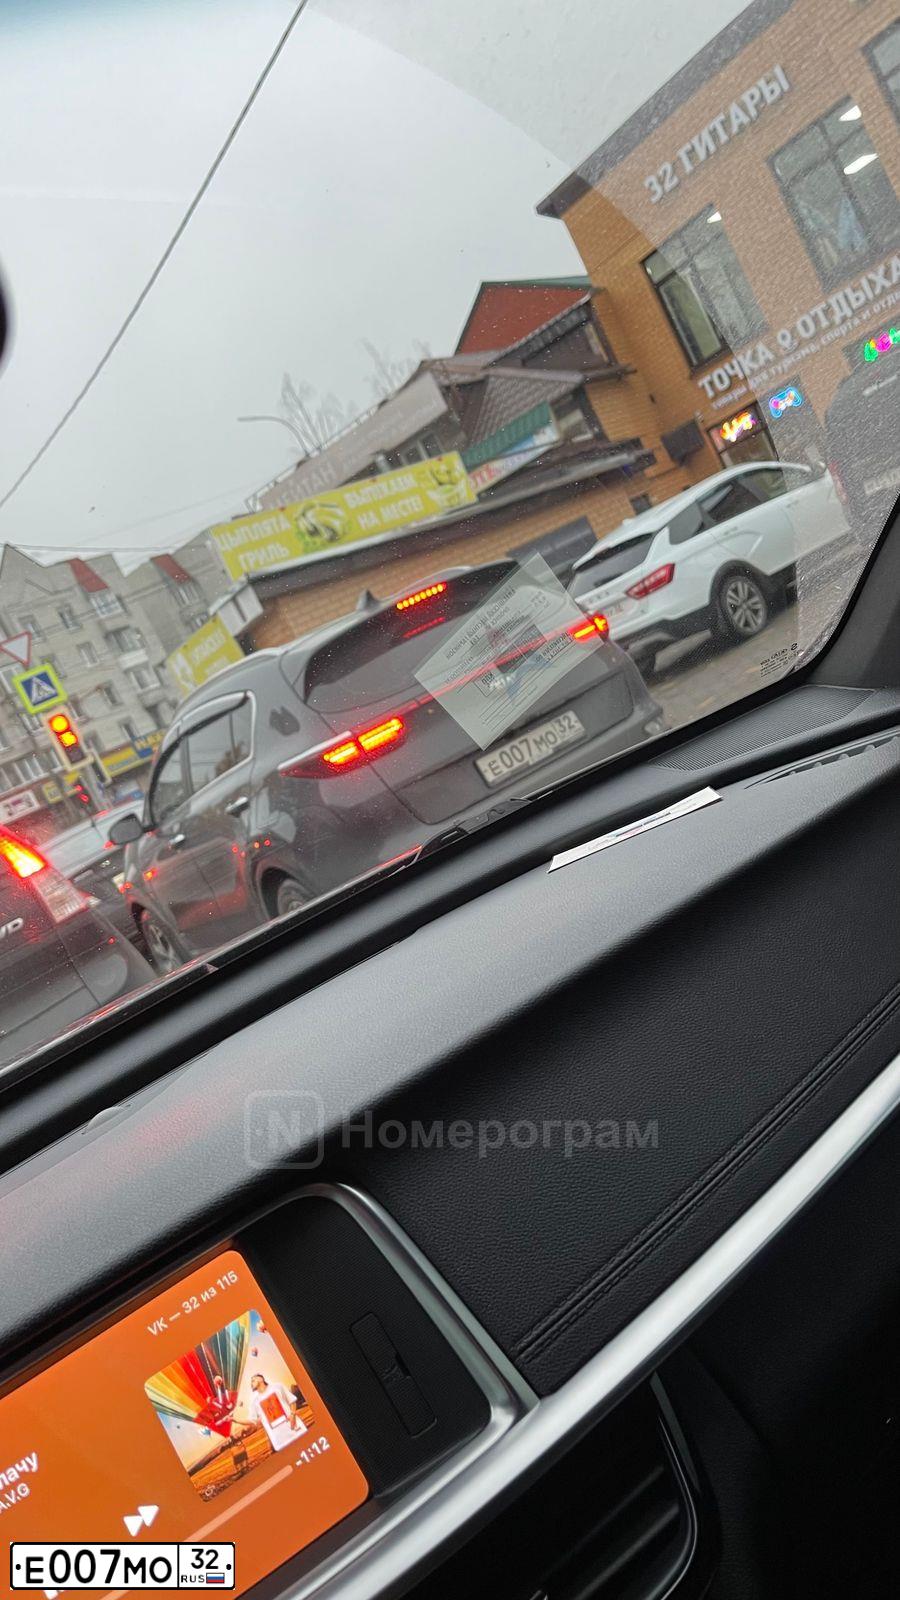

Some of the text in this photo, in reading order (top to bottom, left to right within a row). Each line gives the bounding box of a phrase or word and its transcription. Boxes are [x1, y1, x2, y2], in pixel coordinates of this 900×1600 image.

[644, 64, 790, 203] 32 ГИТАРЫ
[698, 341, 774, 398] ТОЧКА
[357, 510, 379, 530] НА
[239, 543, 290, 570] ГРИЛЬ
[147, 1317, 168, 1337] VK
[182, 1296, 200, 1315] 32
[201, 1285, 217, 1304] из
[216, 1270, 239, 1293] 115
[295, 1436, 331, 1467] -1:12
